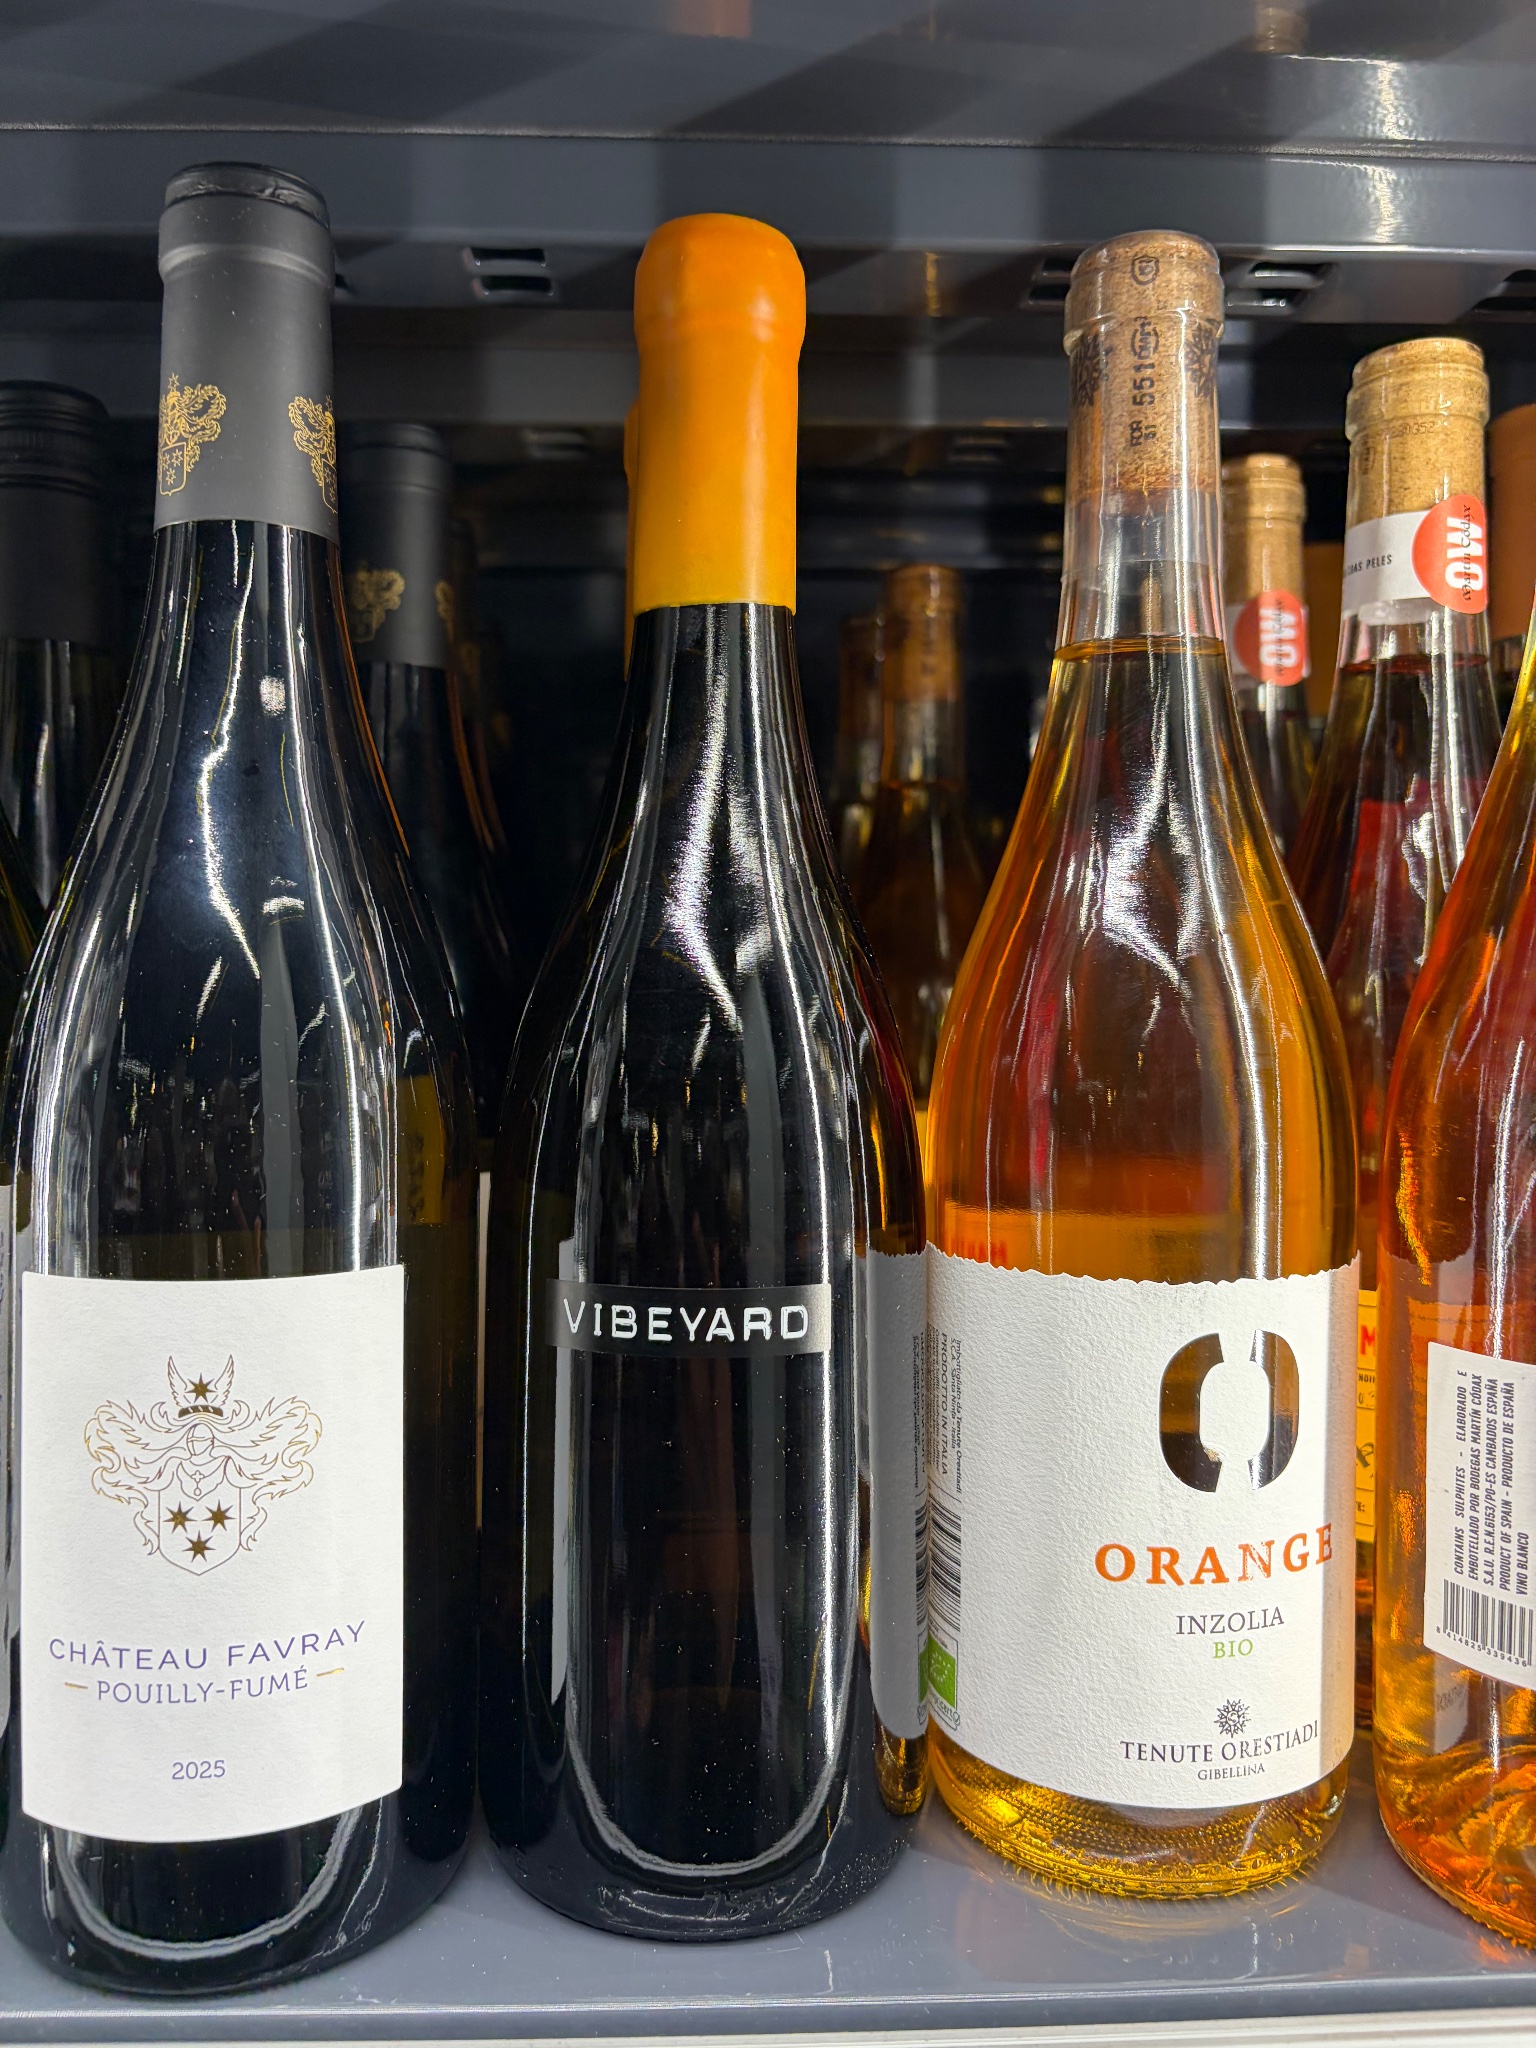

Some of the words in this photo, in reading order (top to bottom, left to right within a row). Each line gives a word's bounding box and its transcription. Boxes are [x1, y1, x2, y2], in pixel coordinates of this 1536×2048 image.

[1365, 554, 1392, 570] PELES
[563, 1298, 809, 1342] VIBEYARD
[1470, 1374, 1482, 1412] CÓDAX
[1486, 1378, 1498, 1419] ESPAÑA
[1501, 1382, 1515, 1419] ESPAÑA
[1456, 1386, 1467, 1443] ELABORADO
[1469, 1412, 1481, 1445] MARTÍN
[1502, 1421, 1514, 1435] DE
[1485, 1420, 1498, 1470] CAMBADOS
[1501, 1437, 1514, 1488] PRODUCTO
[1469, 1447, 1481, 1491] BODEGAS
[1455, 1465, 1466, 1518] SULPHITES
[1470, 1492, 1480, 1514] POR
[1500, 1499, 1512, 1530] SPAIN
[1094, 1522, 1333, 1587] ORANGE
[1454, 1526, 1465, 1576] CONTAINS
[1468, 1516, 1480, 1581] EMBOTELLADO
[1500, 1531, 1512, 1544] OF
[1516, 1532, 1529, 1570] BLANCO
[1484, 1558, 1495, 1587] S.A.U.
[1499, 1545, 1511, 1592] PRODUCT
[1515, 1573, 1528, 1596] VINO
[1175, 1606, 1285, 1635] INZOLIA
[48, 1639, 208, 1671] CHÂTEAU
[227, 1620, 366, 1667] FAVRAY
[1212, 1638, 1254, 1660] BIO
[1446, 1631, 1482, 1652] 414825
[1485, 1647, 1527, 1668] 339436
[96, 1664, 309, 1704] POUILLY-FUMÉ
[1119, 1740, 1214, 1764] TENUTE
[1221, 1719, 1319, 1761] ORESTIADI
[171, 1758, 227, 1781] 2025
[1197, 1762, 1266, 1781] GIBELLINA
